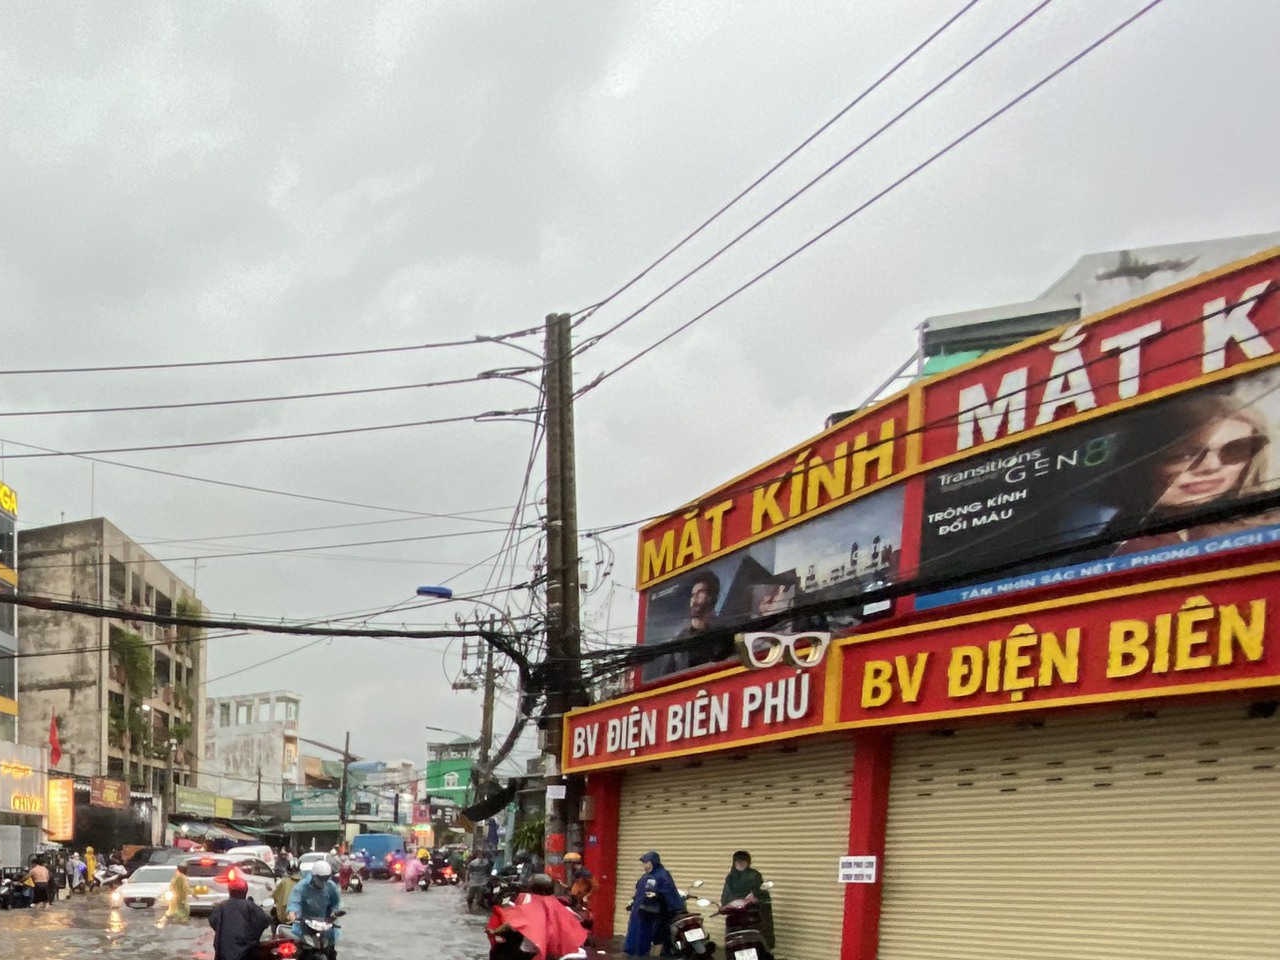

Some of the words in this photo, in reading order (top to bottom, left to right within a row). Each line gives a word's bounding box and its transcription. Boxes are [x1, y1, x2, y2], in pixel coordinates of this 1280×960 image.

[957, 322, 1162, 451] MẮT
[751, 418, 895, 535] KÍNH
[938, 448, 1047, 487] Transitions
[987, 489, 1028, 508] KÍNH
[1130, 546, 1200, 567] PHONG
[861, 652, 929, 708] BV
[948, 624, 1081, 702] ĐIỆN
[1106, 595, 1267, 679] BIÊN
[573, 724, 599, 759] BV
[606, 706, 657, 756] ĐIỆN
[666, 689, 729, 743] BIÊN
[741, 669, 810, 729] PHỦ
